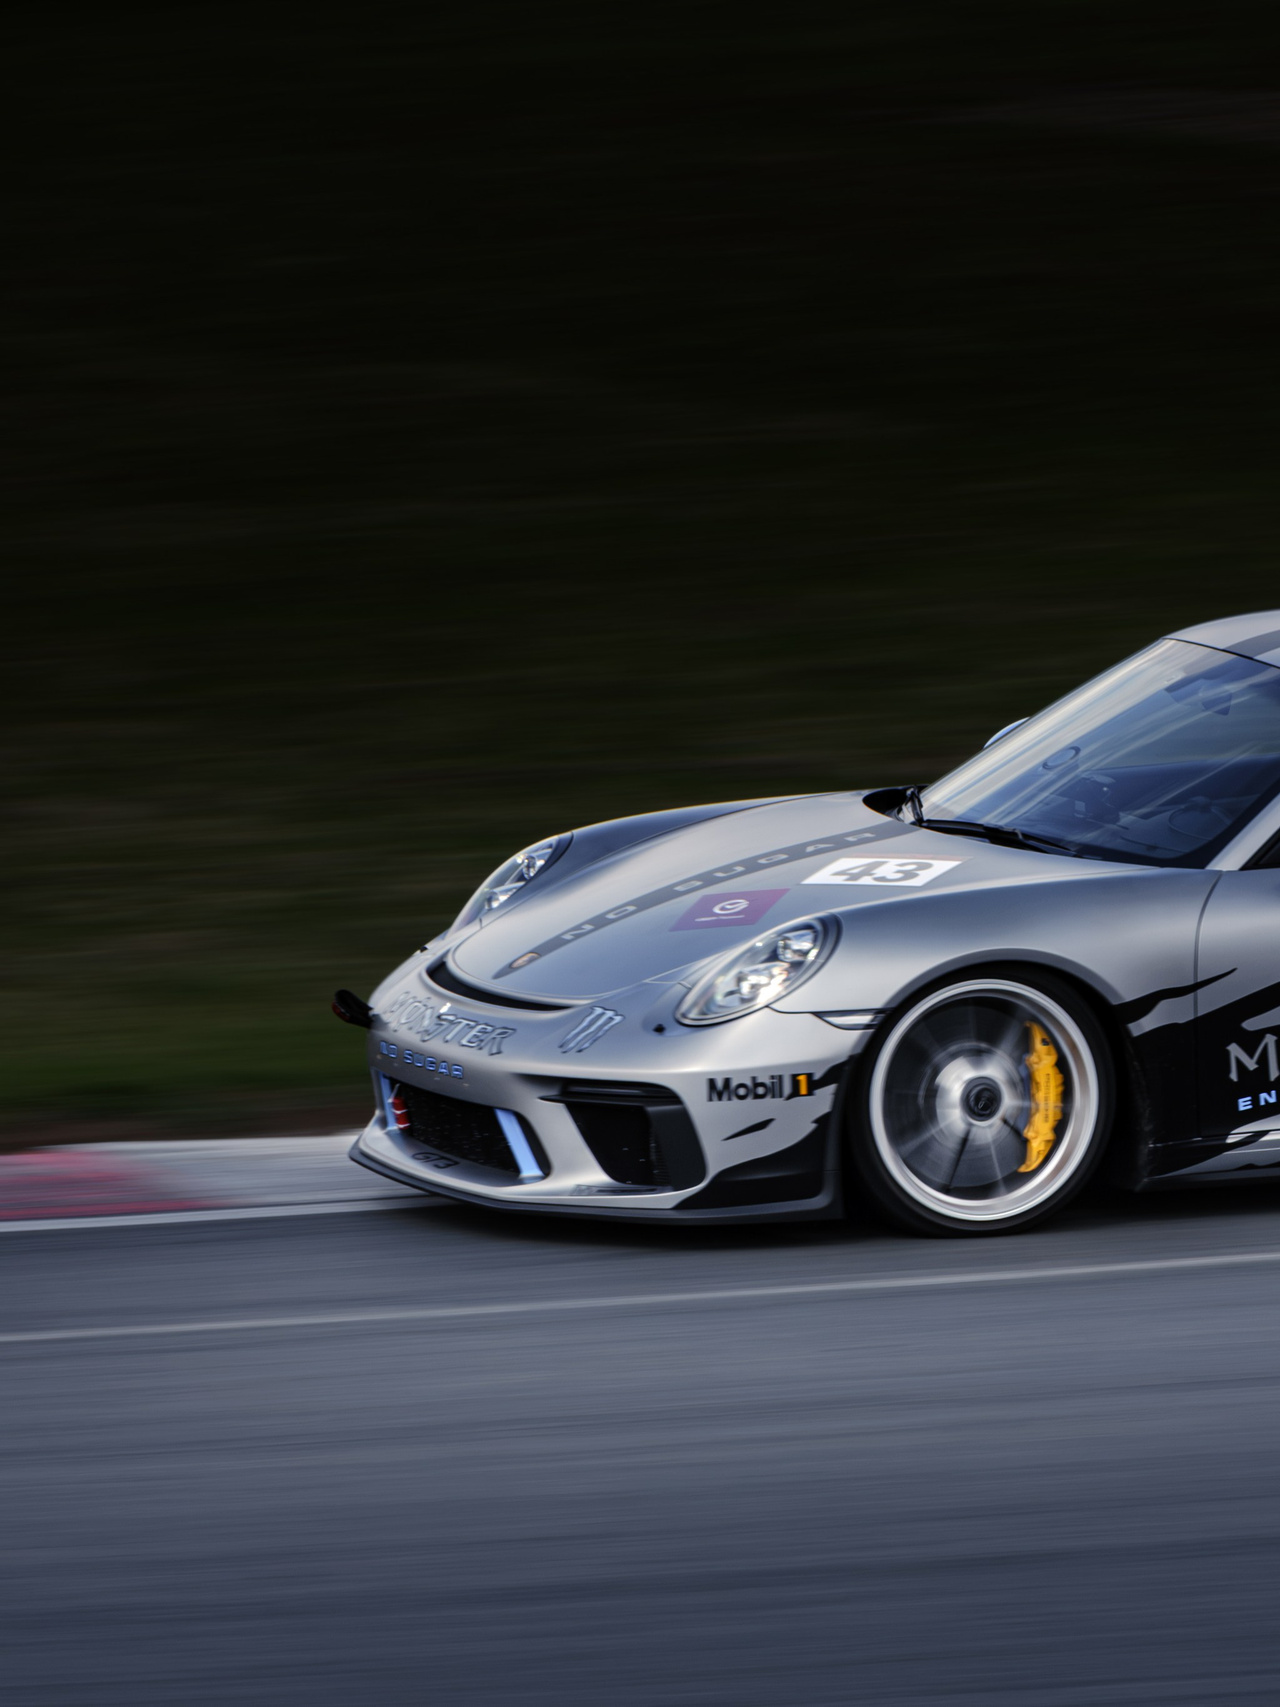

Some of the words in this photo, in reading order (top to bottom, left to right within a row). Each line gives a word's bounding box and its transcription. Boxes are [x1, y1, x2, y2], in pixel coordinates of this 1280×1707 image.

[829, 860, 935, 882] 43
[561, 905, 638, 941] NO
[403, 1049, 464, 1079] SUGAR
[706, 1074, 784, 1102] Mobil
[412, 1152, 461, 1169] GT3
